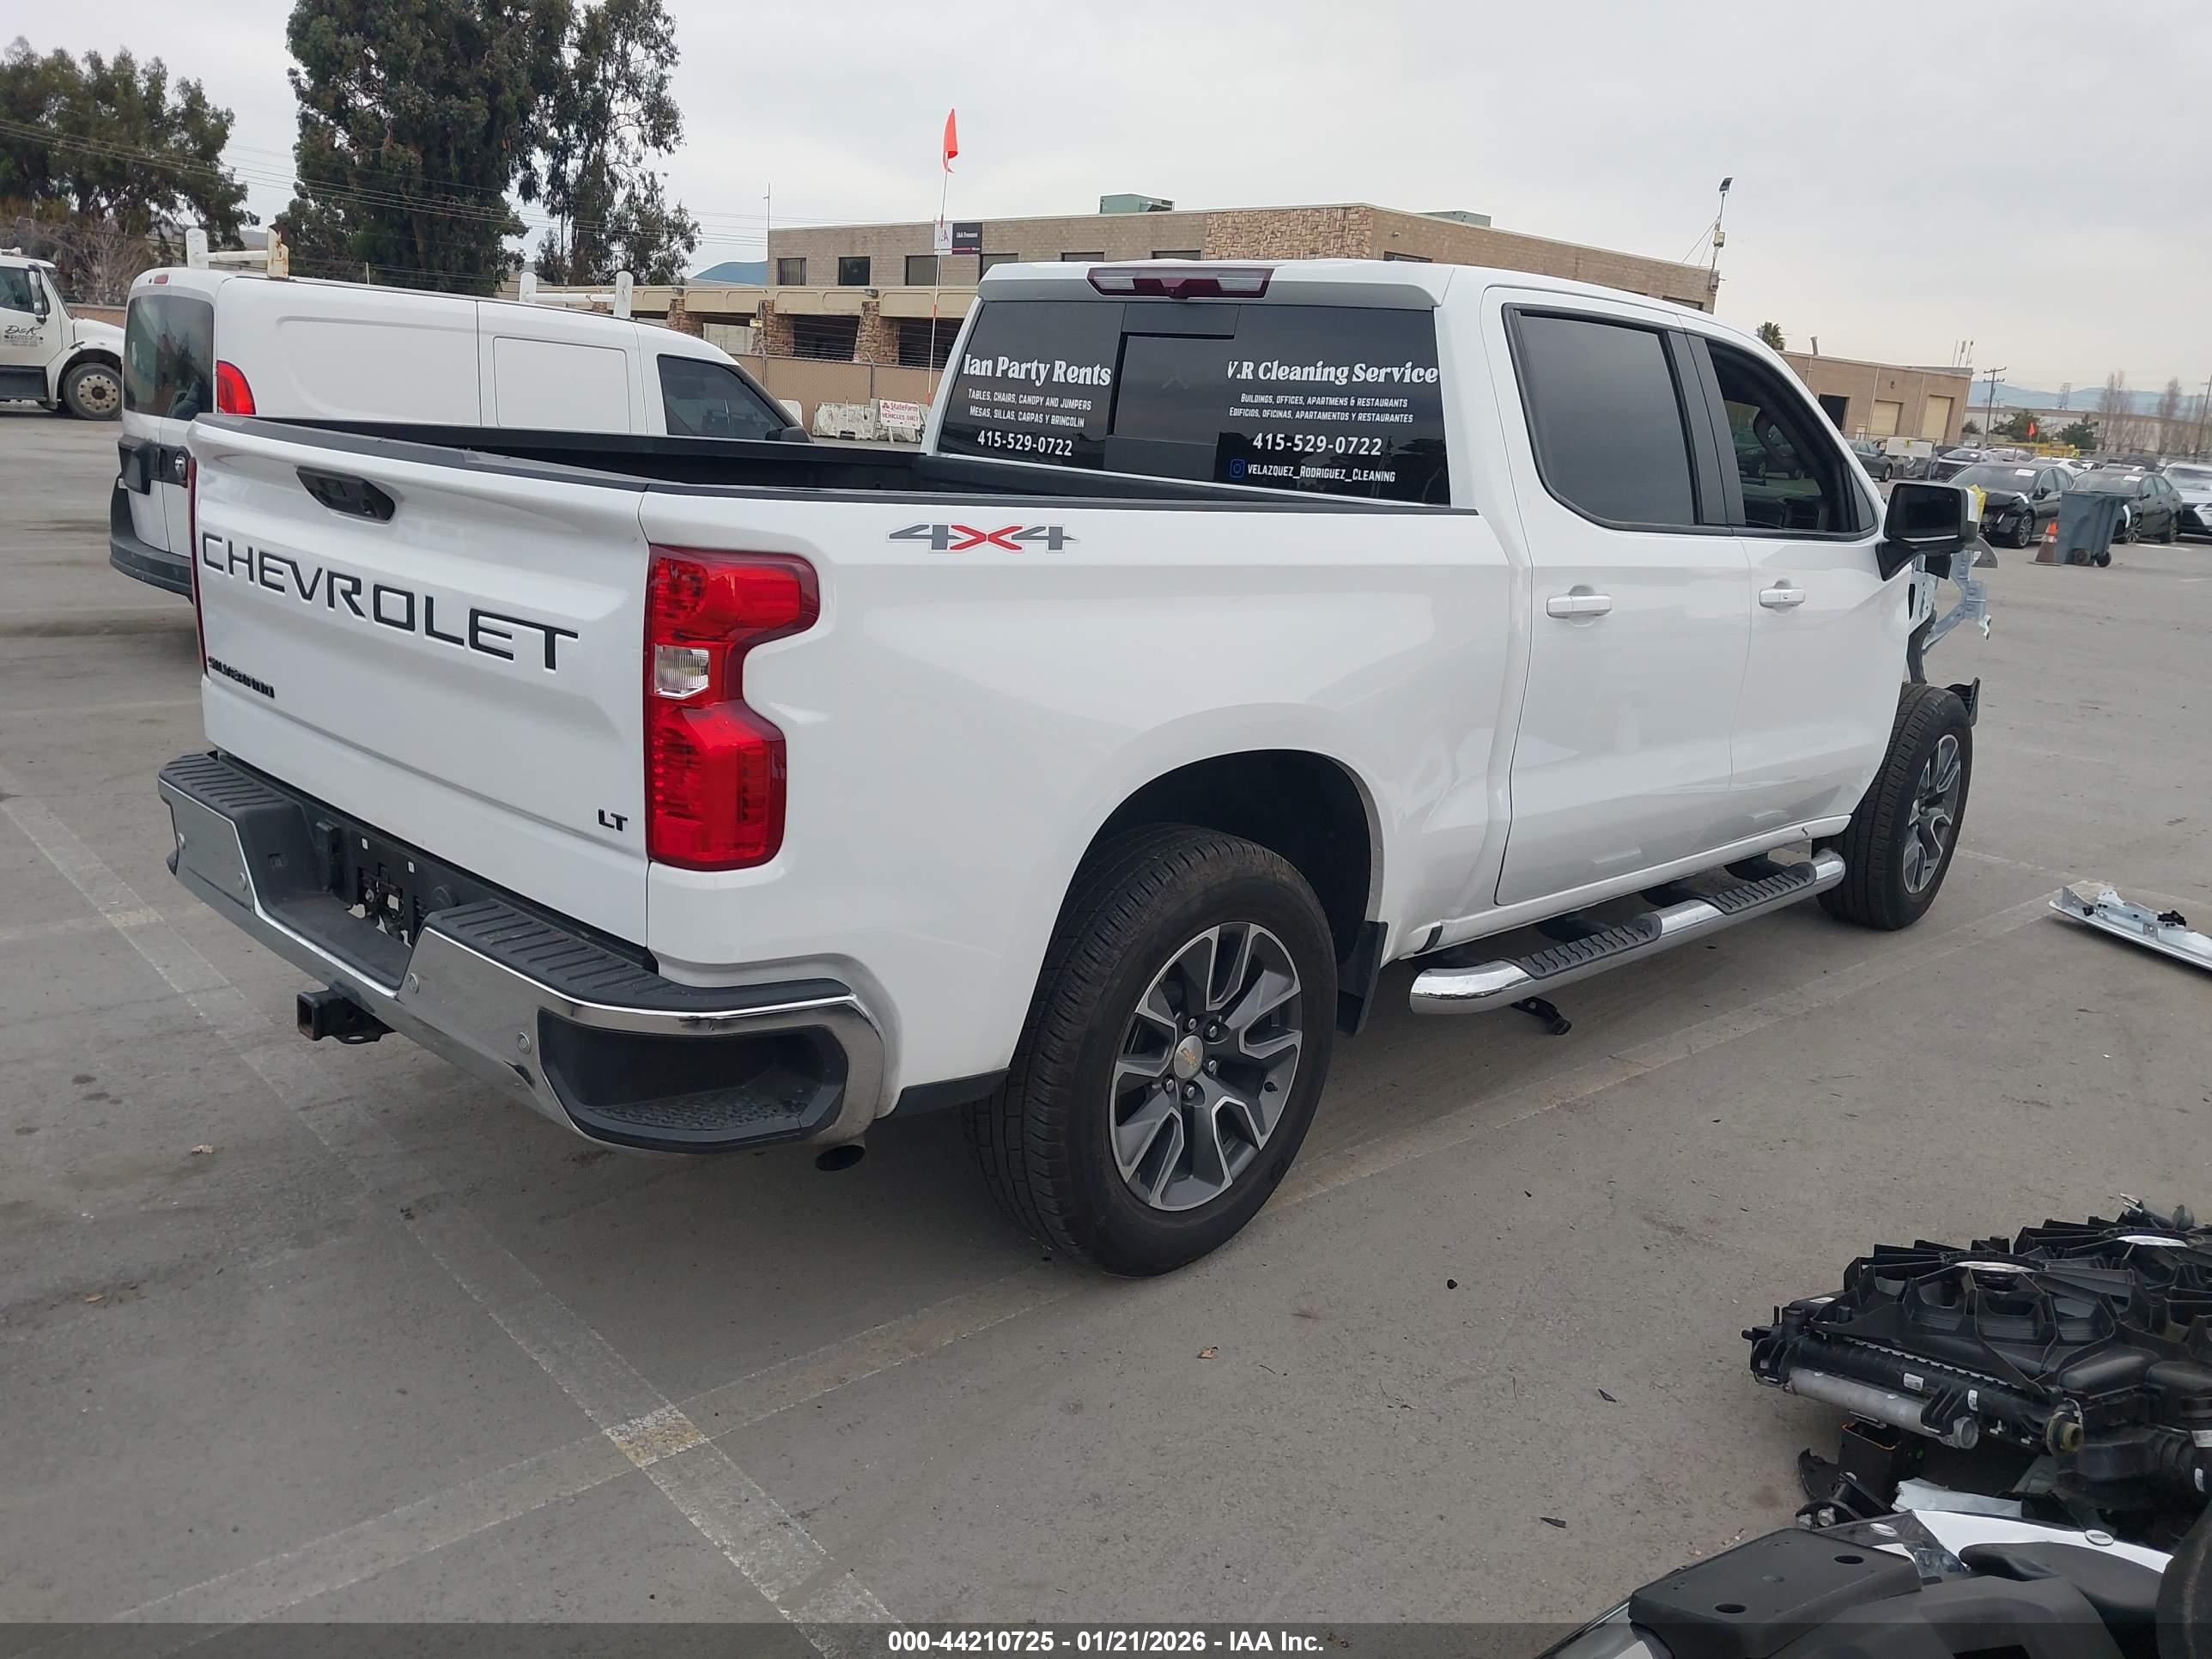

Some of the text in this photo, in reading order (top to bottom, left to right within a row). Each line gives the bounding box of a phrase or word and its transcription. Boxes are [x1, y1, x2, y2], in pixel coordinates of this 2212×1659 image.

[963, 354, 1112, 386] Ian Party Rents
[1226, 360, 1439, 385] V.R Cleaning Service
[968, 388, 1092, 411] TABLES, CHAIRS, CANOPY AND JUMPERS
[1276, 395, 1305, 406] OFFICES,
[1307, 396, 1349, 406] APARTMENS
[1357, 398, 1408, 408] RESTAURANTS
[882, 412, 905, 421] VEHICLES
[969, 405, 1085, 428] MESAS, SILLAS, CARPAS Y BRINCOLIN
[1262, 409, 1293, 420] OFICINAS,
[1295, 410, 1350, 421] APARTAMENTOS
[1352, 411, 1357, 422] Y
[1357, 412, 1414, 423] RESTAURANTES
[976, 430, 1073, 457] 415-529-0722
[1253, 432, 1382, 455] 415-529-0722
[203, 532, 579, 672] CHEVROLET
[598, 808, 629, 832] LT
